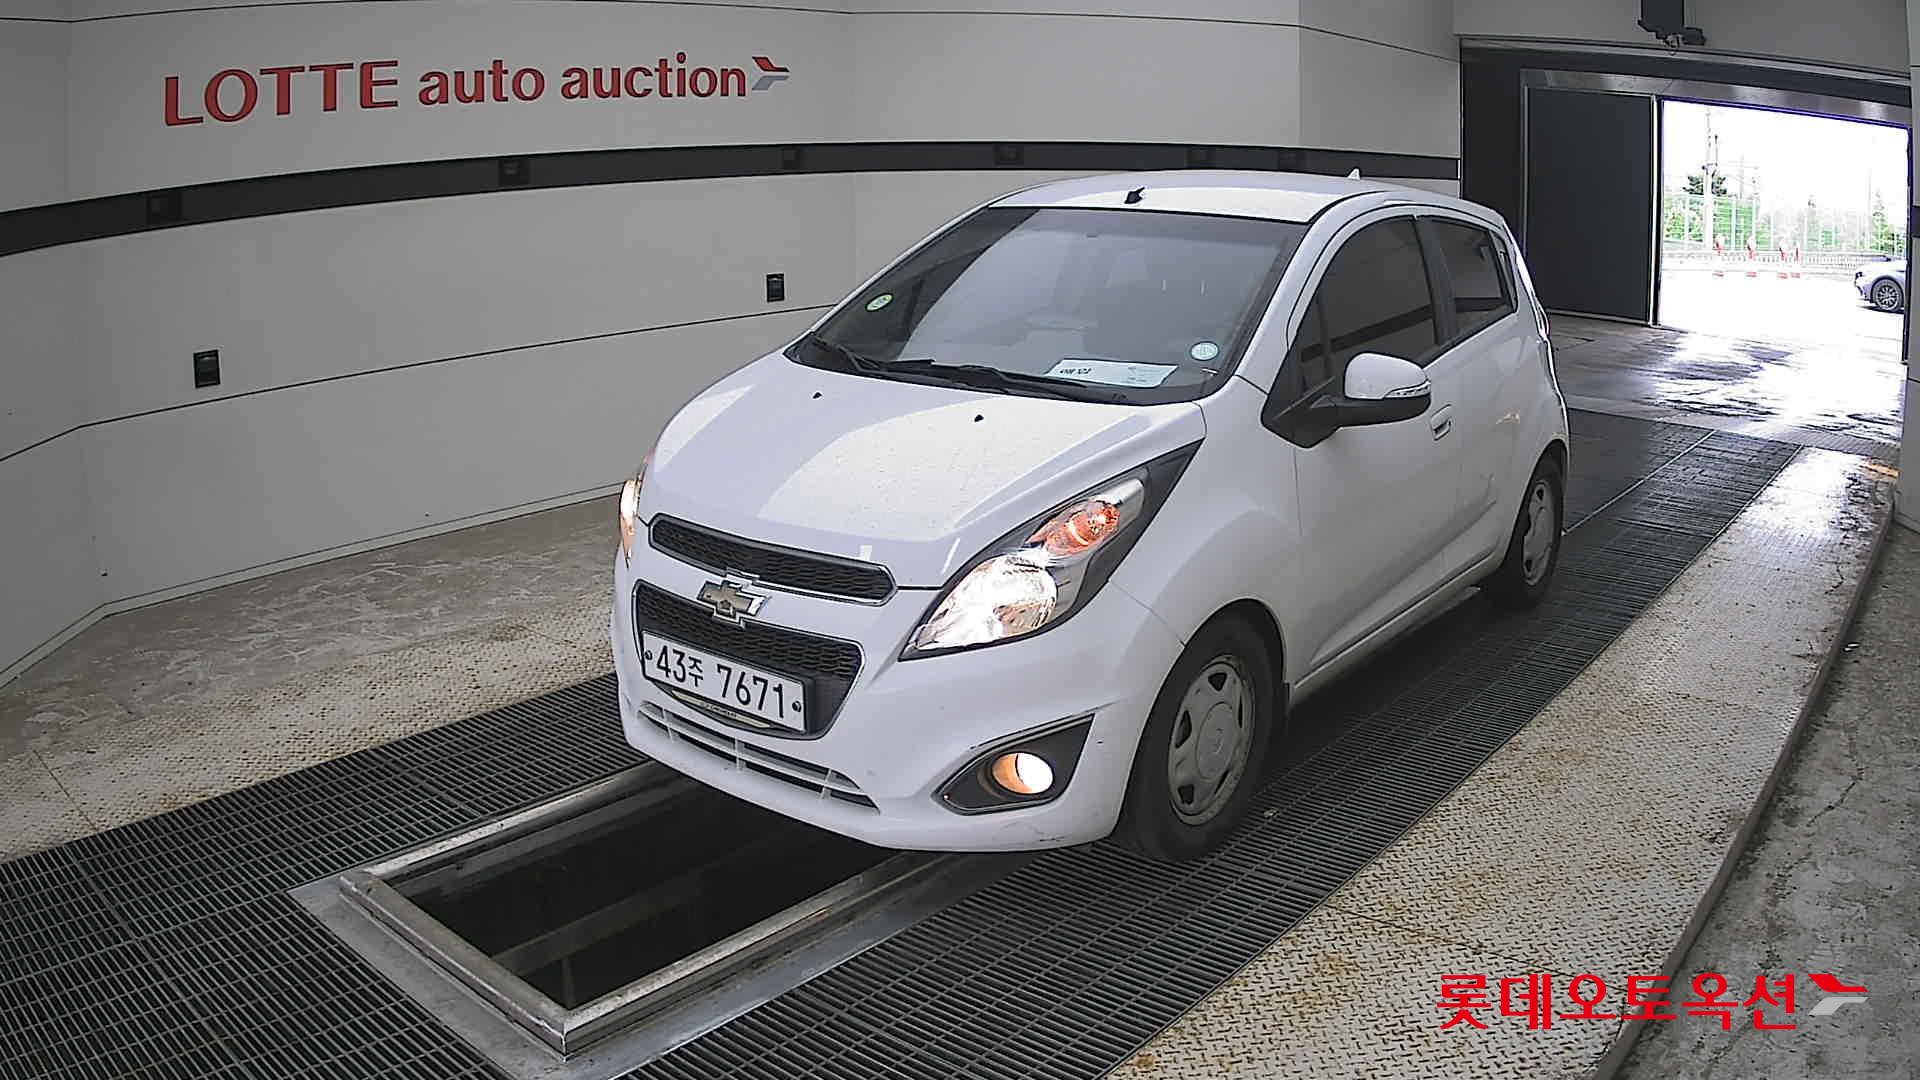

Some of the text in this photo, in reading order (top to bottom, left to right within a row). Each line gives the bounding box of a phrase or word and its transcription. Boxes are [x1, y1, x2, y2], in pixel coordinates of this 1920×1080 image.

[164, 52, 748, 126] LOTTE auto auction
[656, 645, 784, 718] 43주 7671
